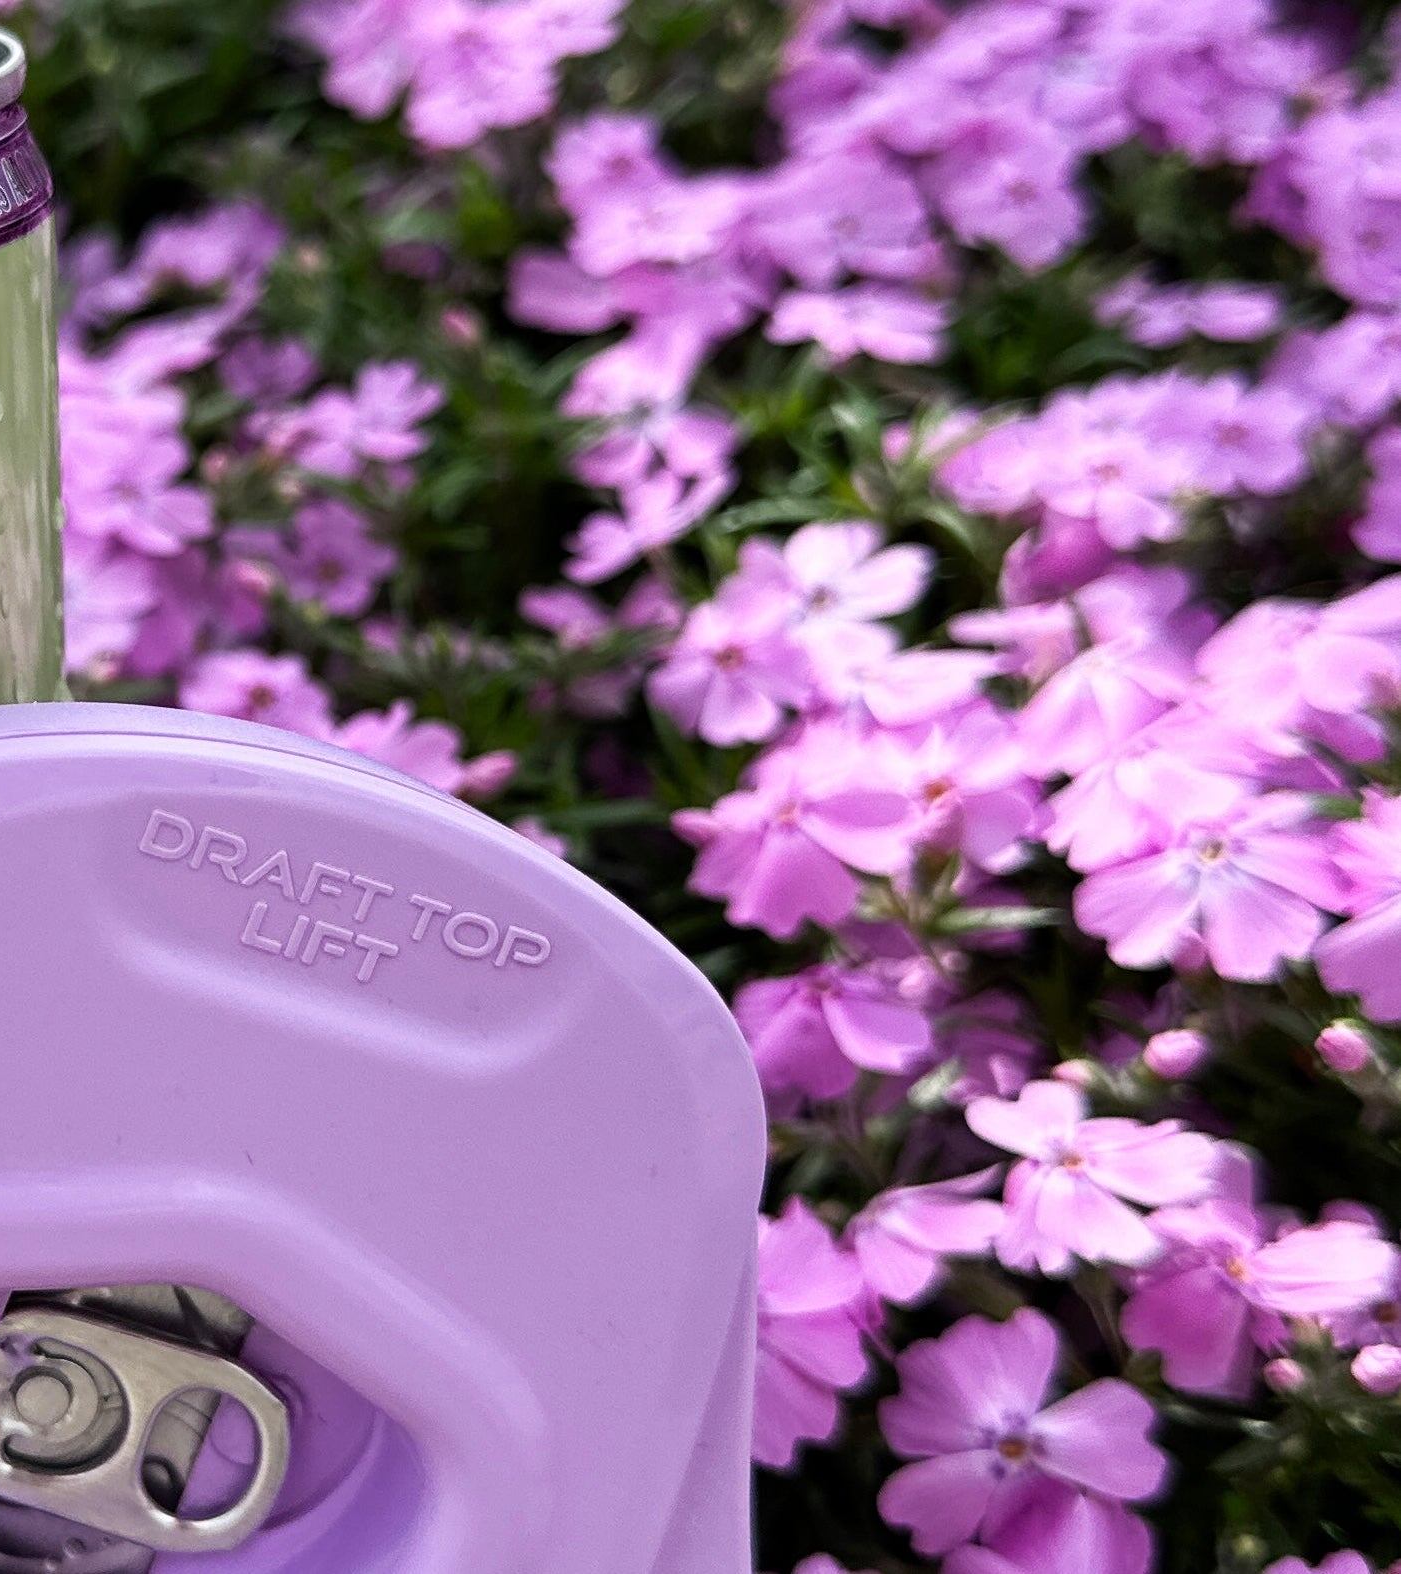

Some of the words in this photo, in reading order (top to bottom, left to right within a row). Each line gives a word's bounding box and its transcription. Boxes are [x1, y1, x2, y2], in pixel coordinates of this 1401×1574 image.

[138, 807, 395, 922] DRAFT
[410, 893, 552, 968] TOP
[240, 901, 399, 984] LIFT
